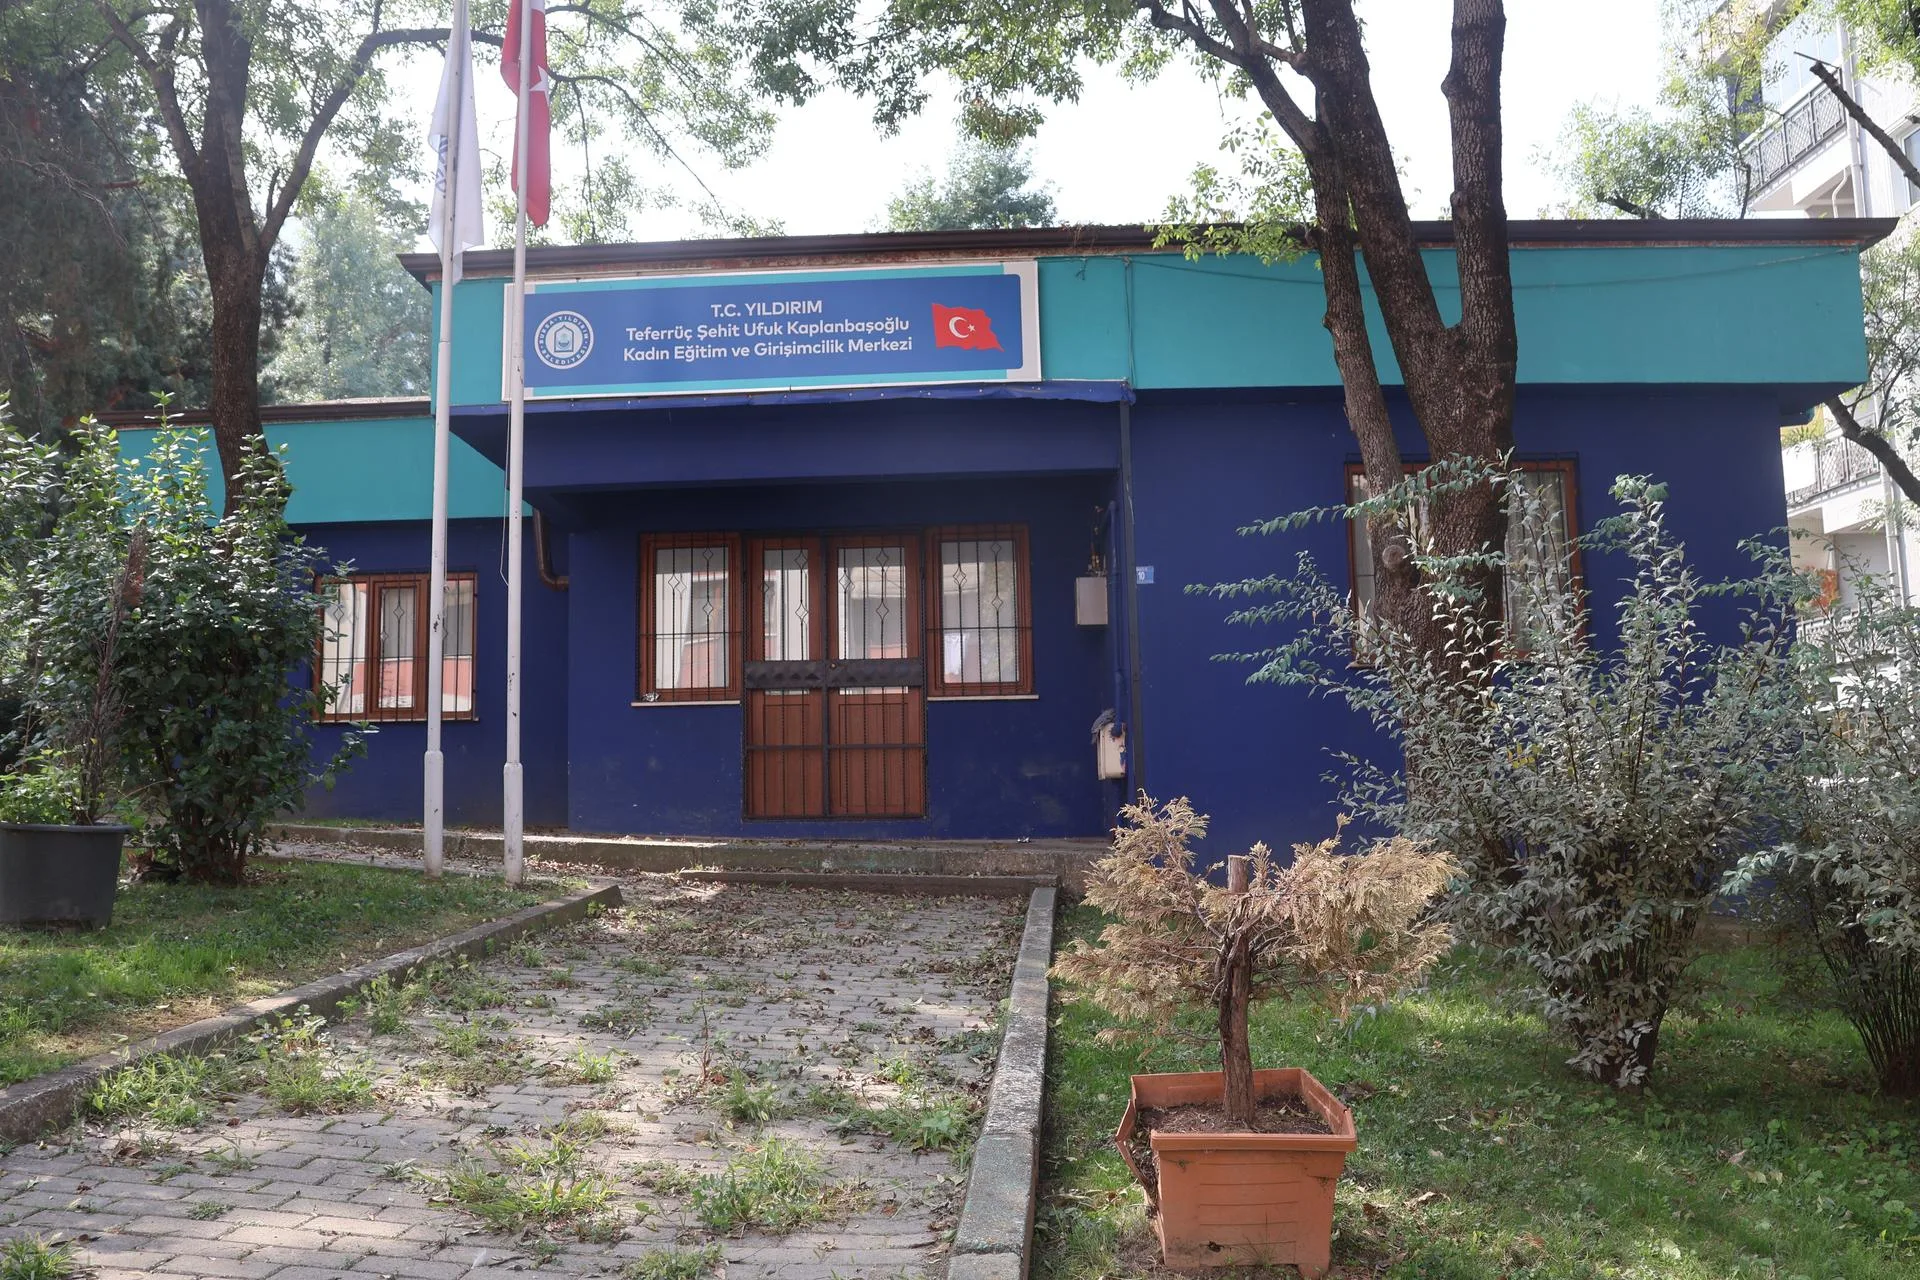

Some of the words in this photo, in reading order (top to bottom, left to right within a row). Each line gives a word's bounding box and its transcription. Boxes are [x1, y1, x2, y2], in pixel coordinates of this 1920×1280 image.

[711, 304, 742, 318] T.C.
[745, 300, 823, 317] YILDIRIM
[625, 325, 693, 342] Teferrüç
[697, 323, 740, 341] Şehit
[744, 321, 783, 337] Ufuk
[787, 316, 909, 337] Kaplanbaşoğlu
[623, 346, 670, 362] Kadın
[674, 344, 728, 363] Eğitim
[731, 346, 750, 358] ve
[754, 339, 844, 358] Girişimcilik
[848, 336, 913, 353] Merkezi
